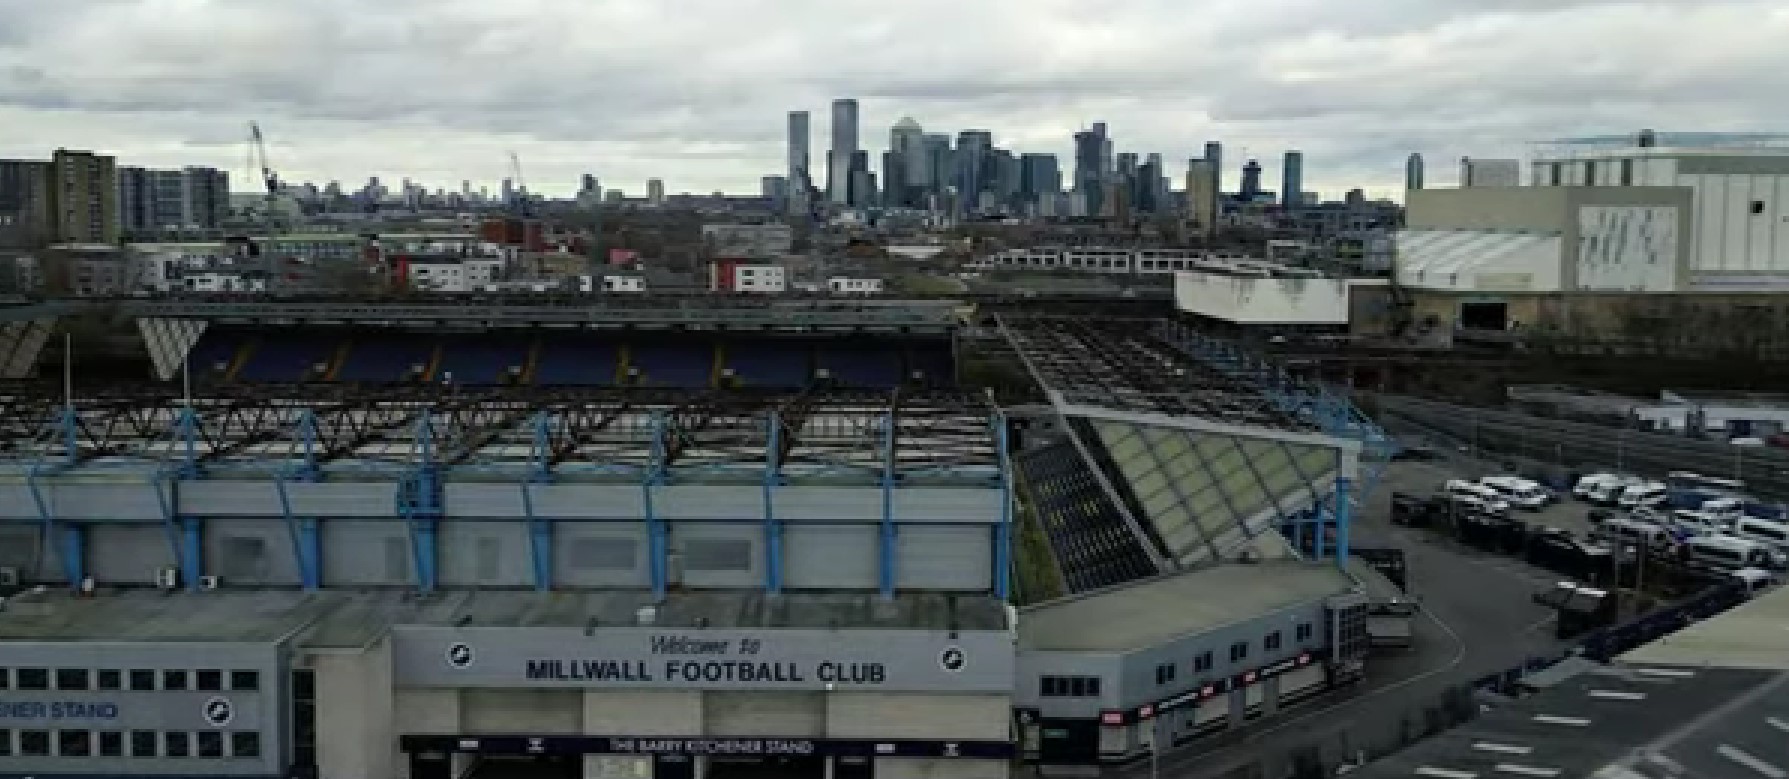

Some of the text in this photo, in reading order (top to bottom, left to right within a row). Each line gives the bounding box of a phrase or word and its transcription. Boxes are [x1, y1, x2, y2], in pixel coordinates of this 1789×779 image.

[651, 635, 761, 655] Welcome to
[526, 659, 886, 684] MILLWALL FOOTBALL CLUB
[51, 701, 118, 719] STAND
[610, 739, 814, 753] THE BARRY KITCHENER STAND
